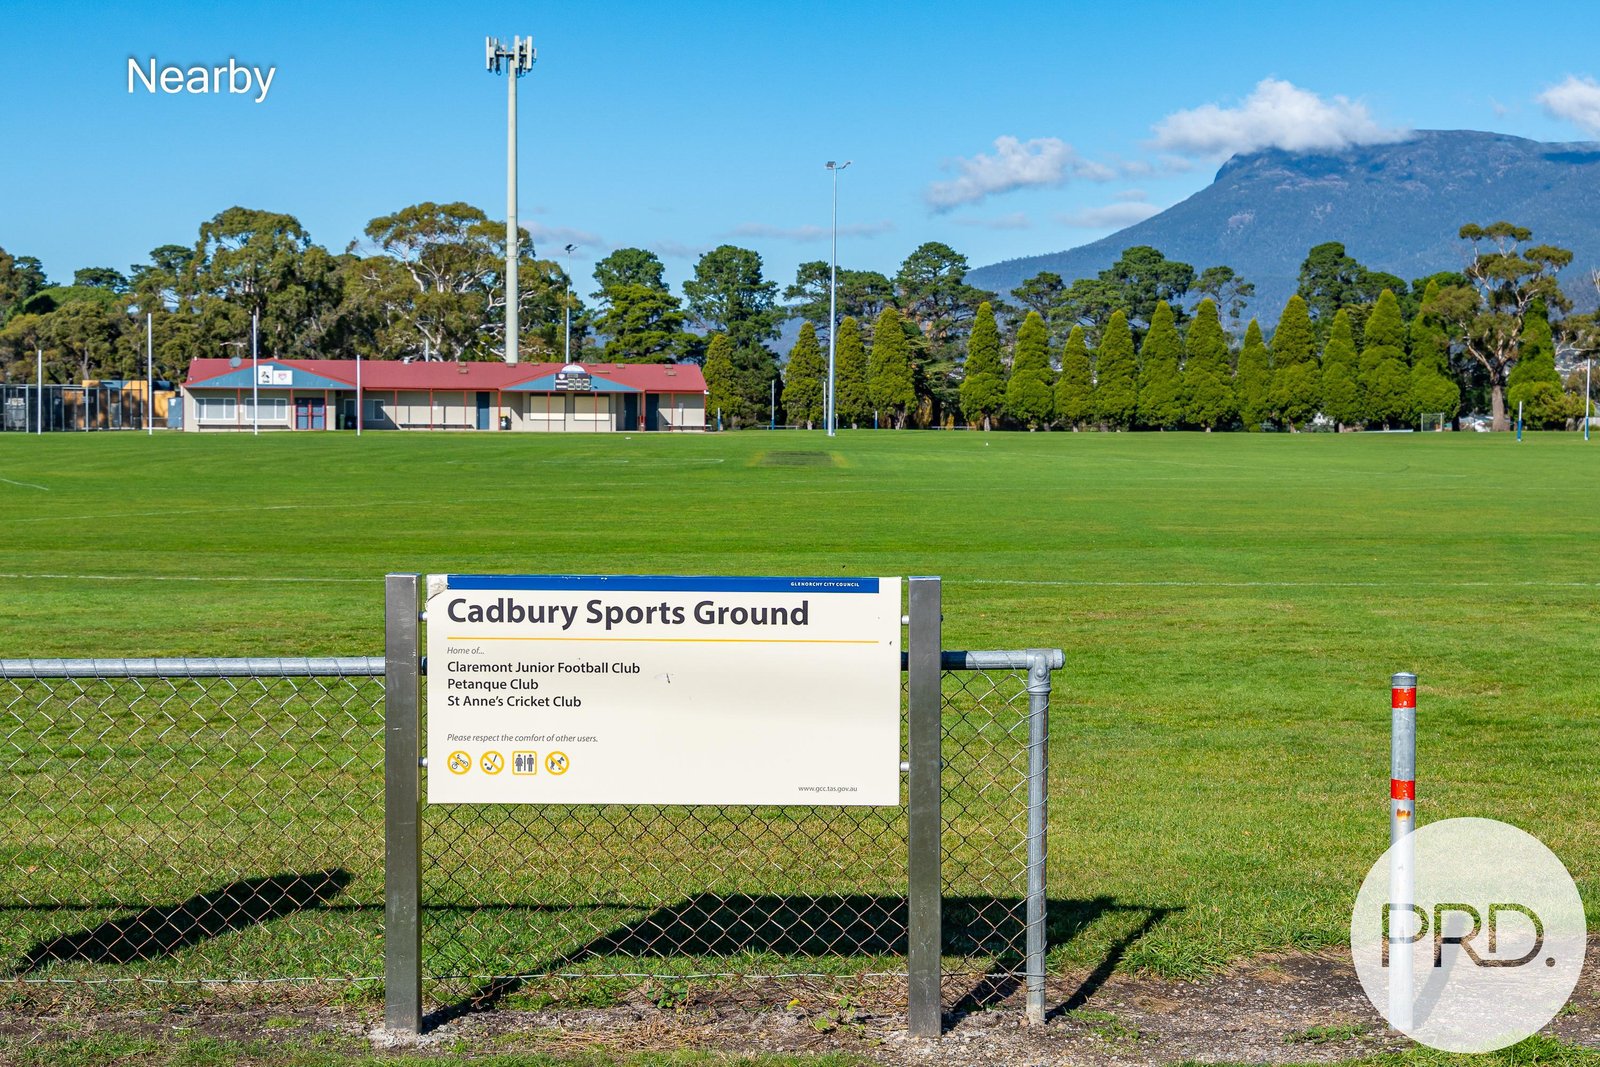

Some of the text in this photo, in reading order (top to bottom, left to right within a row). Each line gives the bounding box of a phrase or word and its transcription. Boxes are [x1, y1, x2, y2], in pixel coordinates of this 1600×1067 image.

[447, 597, 809, 631] Cadbury Sports Ground
[447, 646, 472, 655] Home
[447, 661, 641, 674] Claremont Junior Football Club
[447, 678, 539, 692] Petanque Club
[447, 695, 460, 707] St
[506, 695, 550, 708] Cricket
[553, 696, 582, 708] Club
[446, 733, 599, 743] Please respect the comfort of other users.
